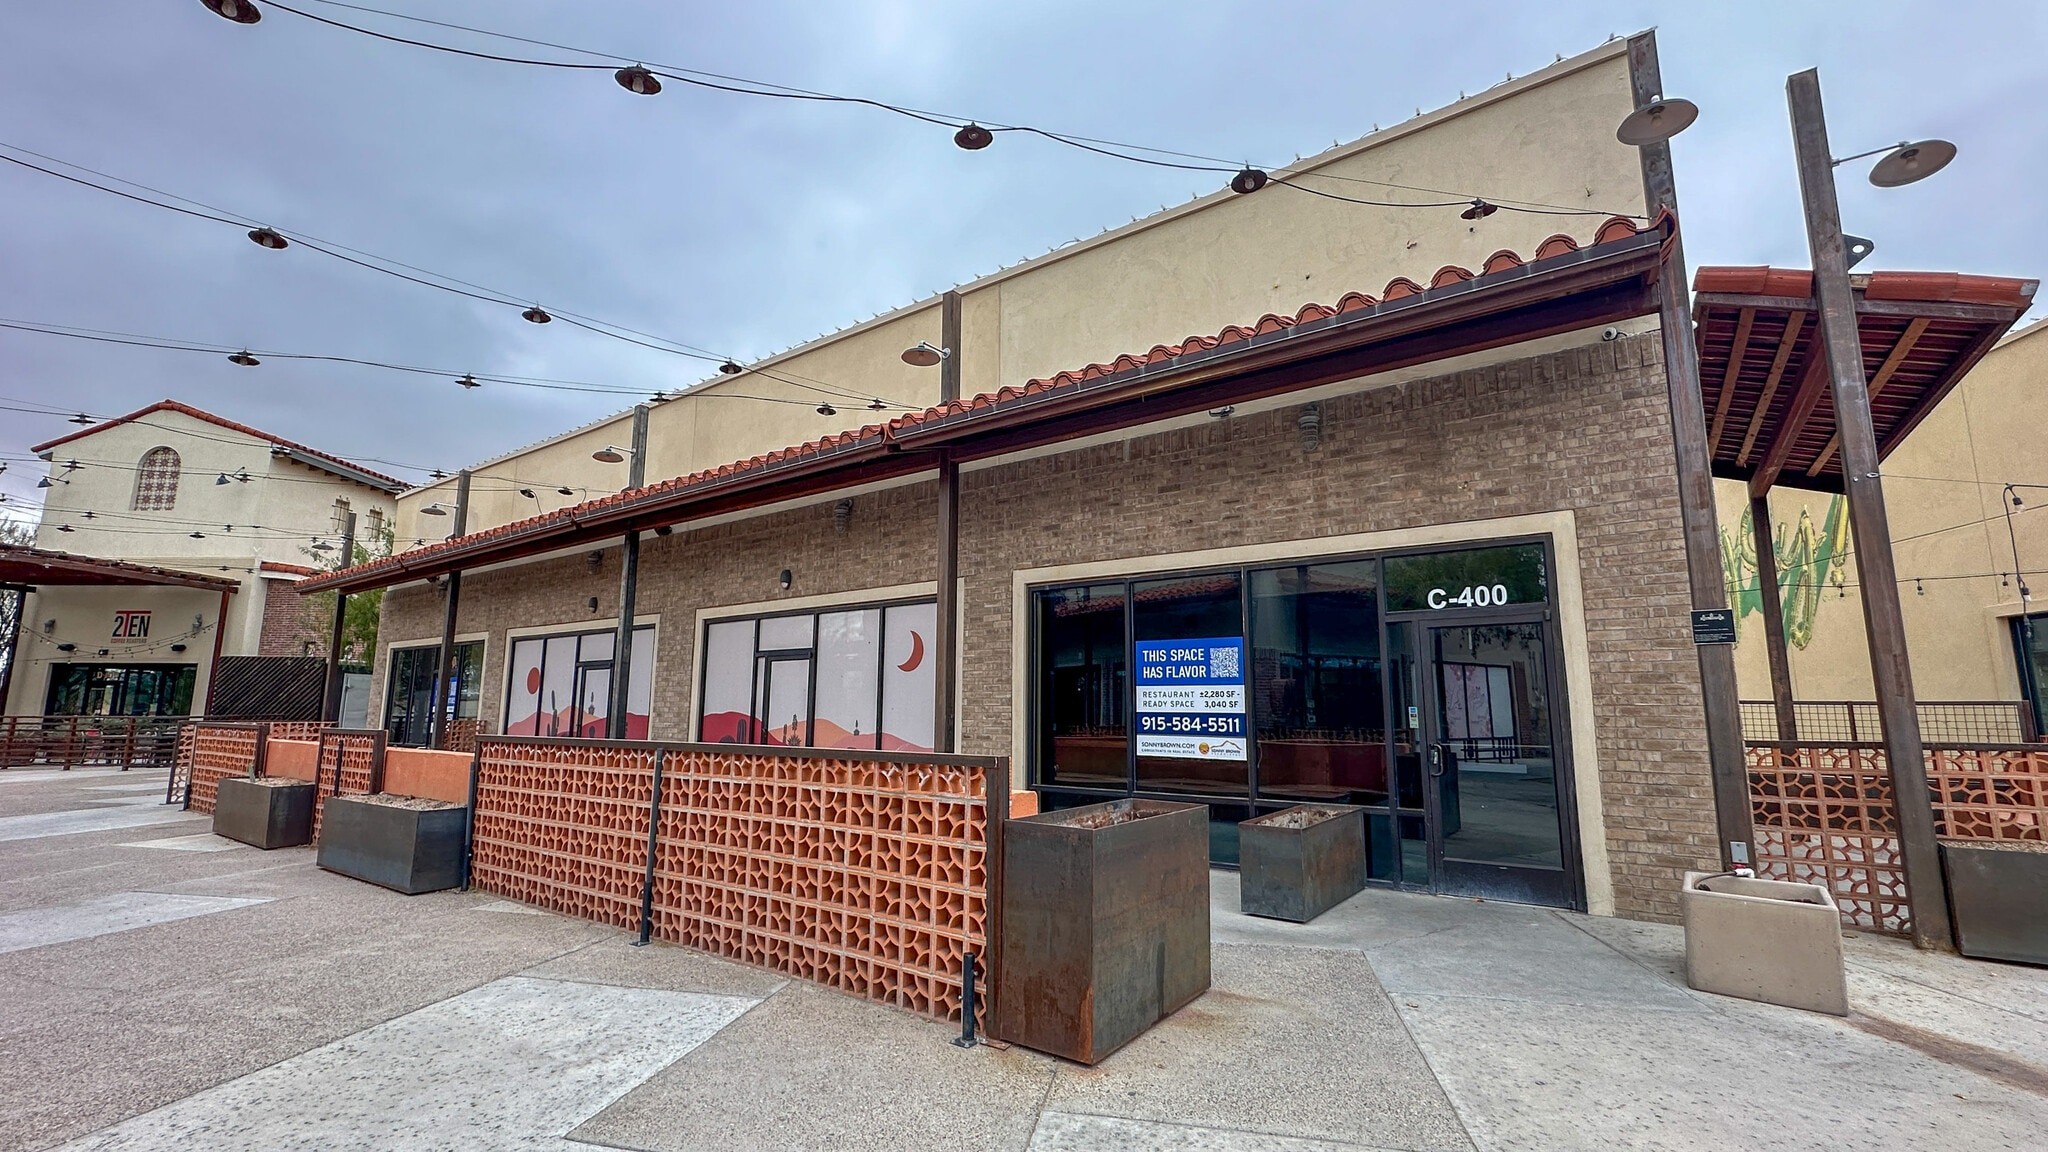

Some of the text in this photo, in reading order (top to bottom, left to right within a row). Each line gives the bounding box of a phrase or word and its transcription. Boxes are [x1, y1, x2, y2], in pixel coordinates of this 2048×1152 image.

[1427, 584, 1507, 610] C-400
[112, 610, 152, 637] 2TEN
[1142, 648, 1205, 662] THIS SPACE
[1143, 665, 1207, 679] HAS FLAVOR
[1142, 700, 1195, 708] READY SPACE
[1141, 716, 1240, 733] 915-584-5511
[1141, 741, 1195, 749] SONNYBROWN.COM
